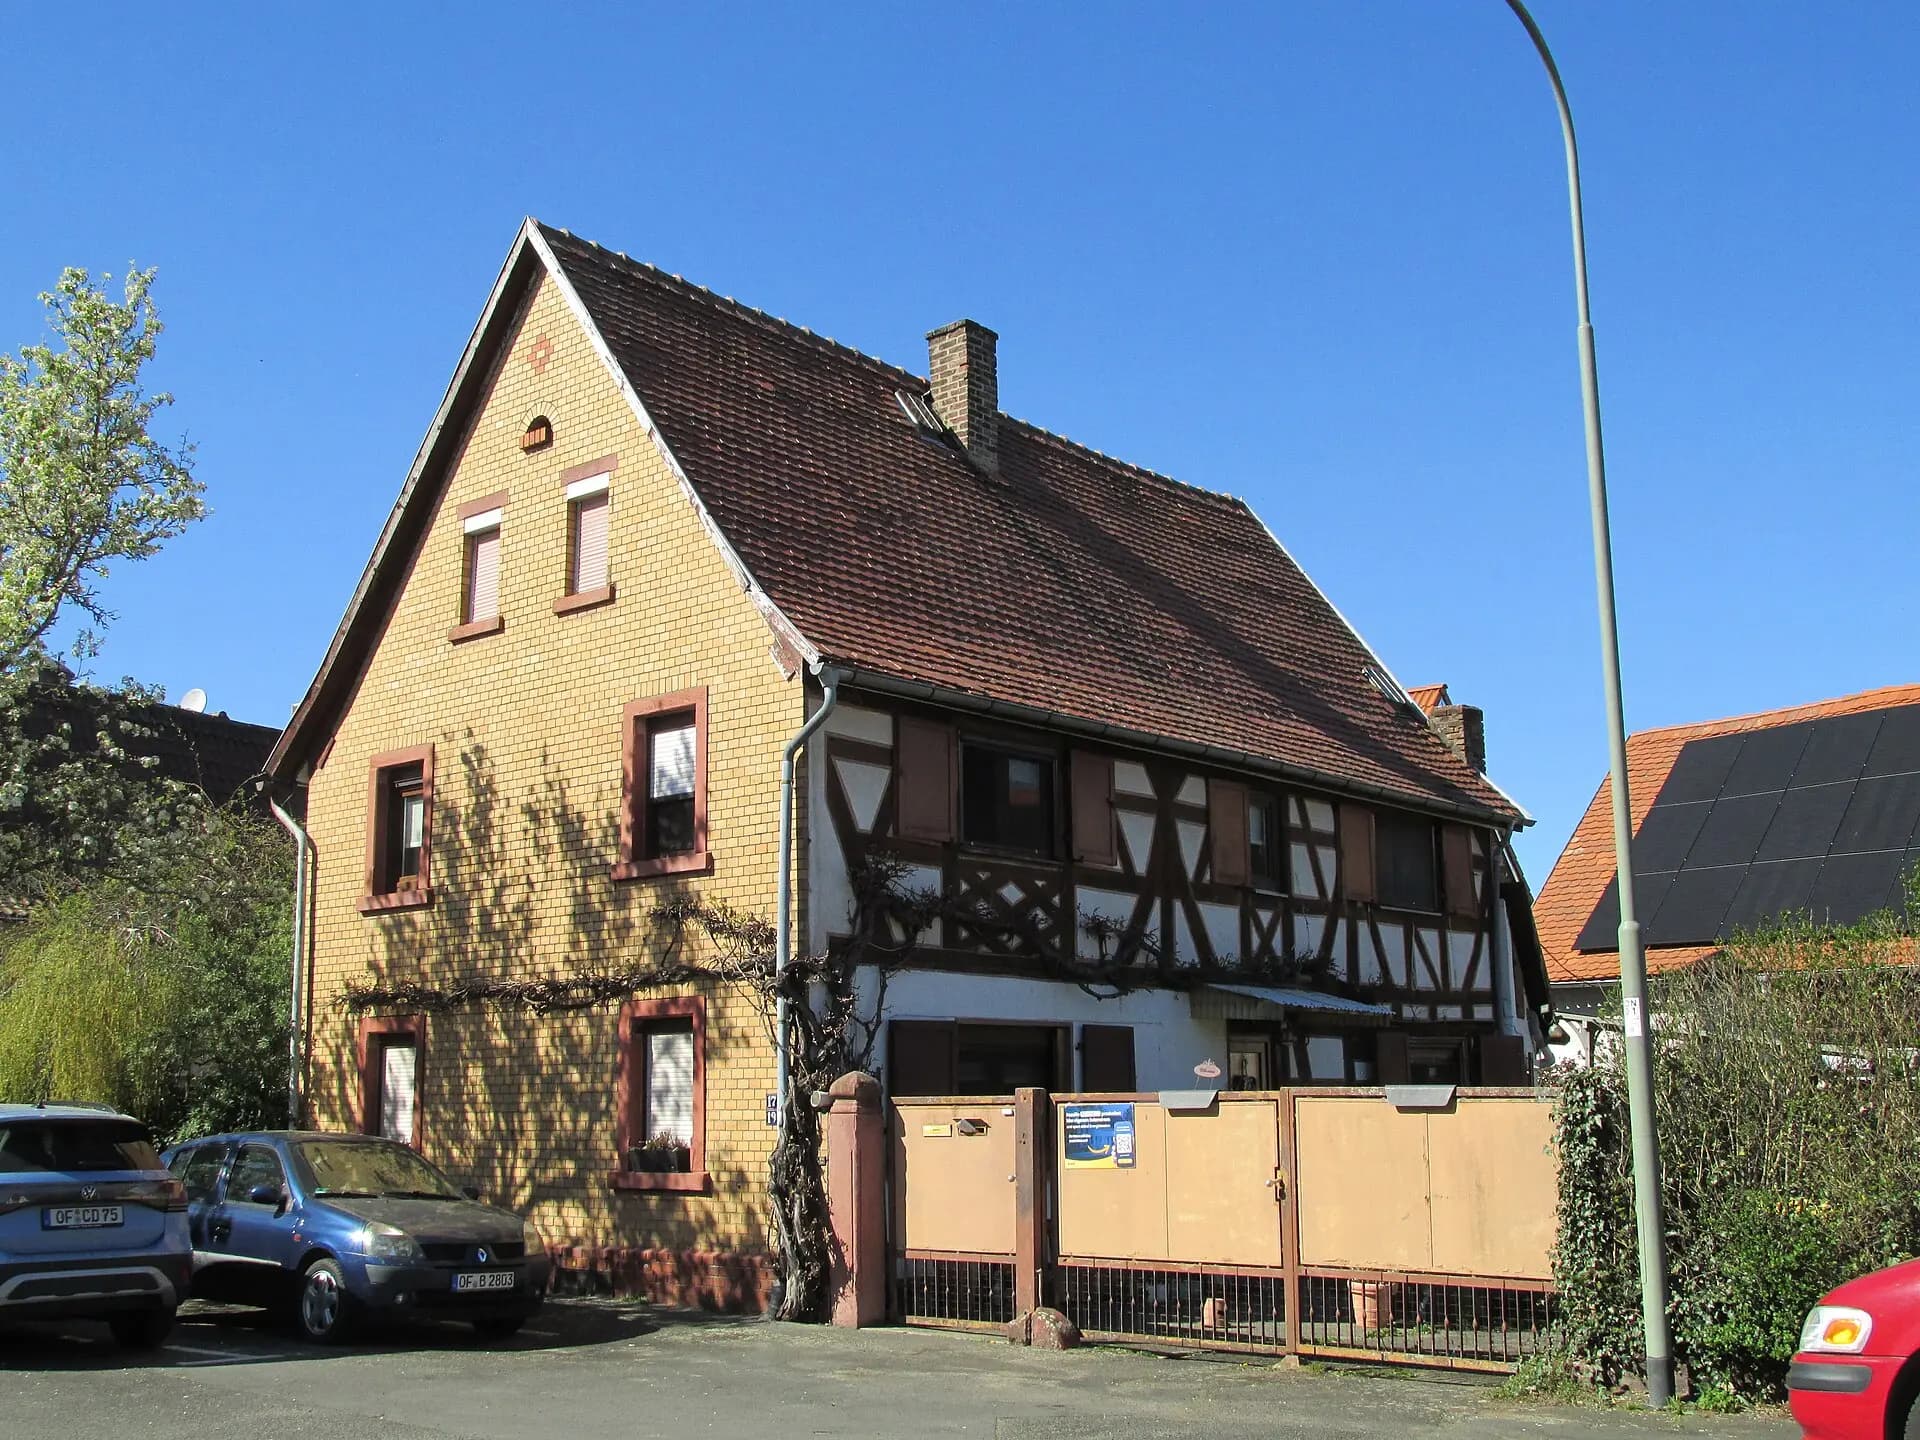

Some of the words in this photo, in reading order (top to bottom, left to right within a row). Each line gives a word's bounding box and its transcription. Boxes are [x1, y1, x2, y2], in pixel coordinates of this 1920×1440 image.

[767, 1095, 777, 1108] 17
[767, 1111, 777, 1124] 19
[55, 1209, 73, 1224] OF
[82, 1208, 100, 1223] CD
[102, 1207, 118, 1222] 75
[459, 1275, 473, 1289] OF
[479, 1274, 487, 1287] B
[488, 1273, 513, 1287] 2803
